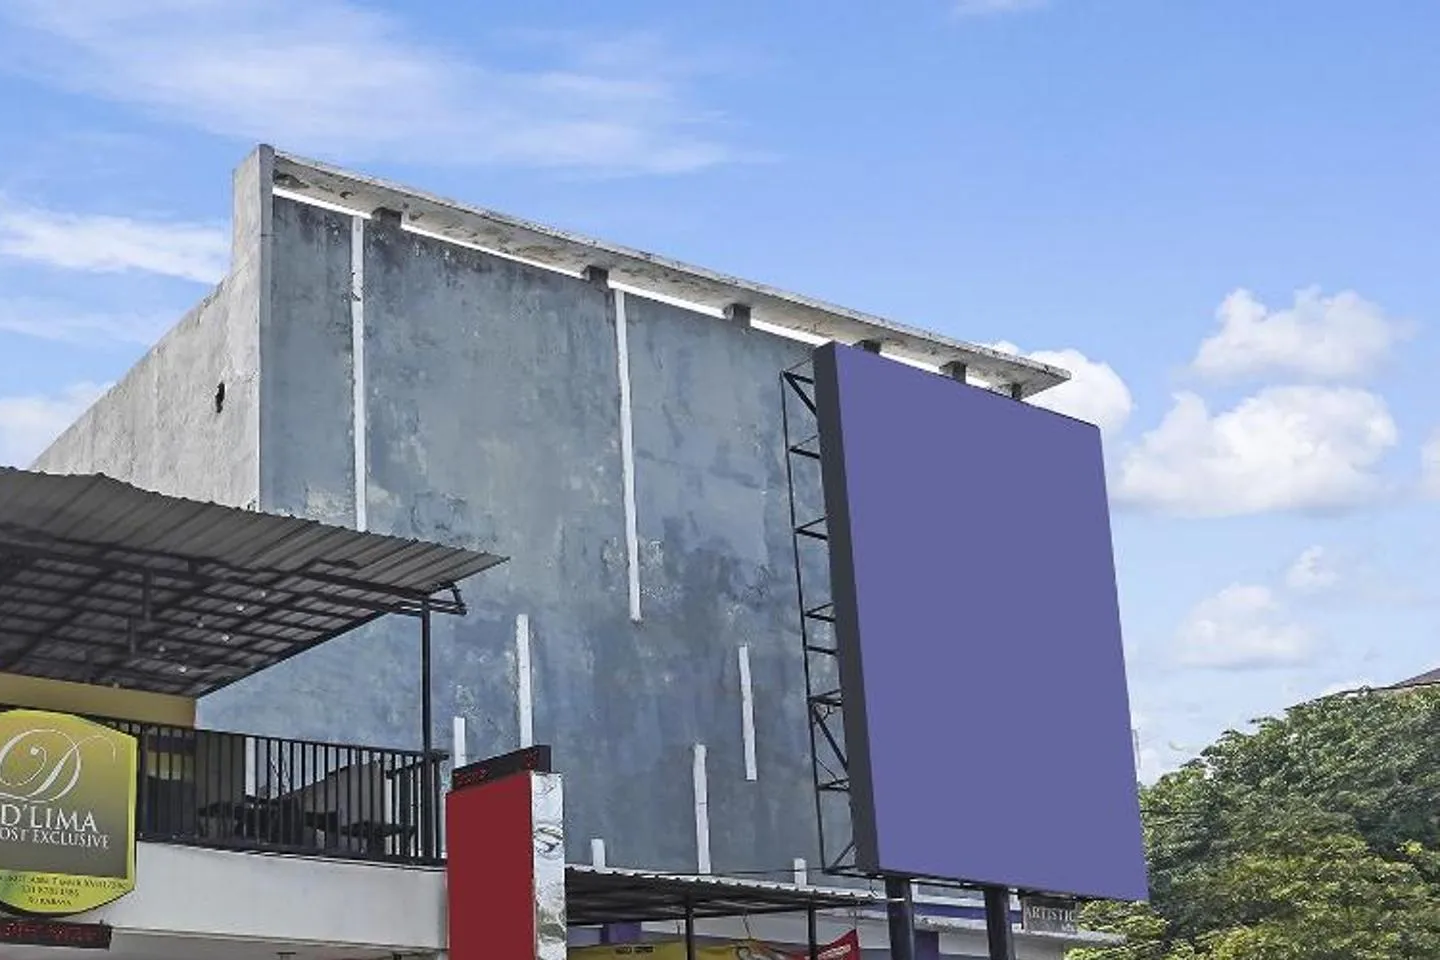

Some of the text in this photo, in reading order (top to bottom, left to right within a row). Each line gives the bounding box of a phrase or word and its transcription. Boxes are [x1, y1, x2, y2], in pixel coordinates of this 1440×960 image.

[0, 803, 99, 834] D'LIMA
[33, 828, 110, 850] EXCLUSIVE
[1025, 905, 1075, 922] ARTISTIC
